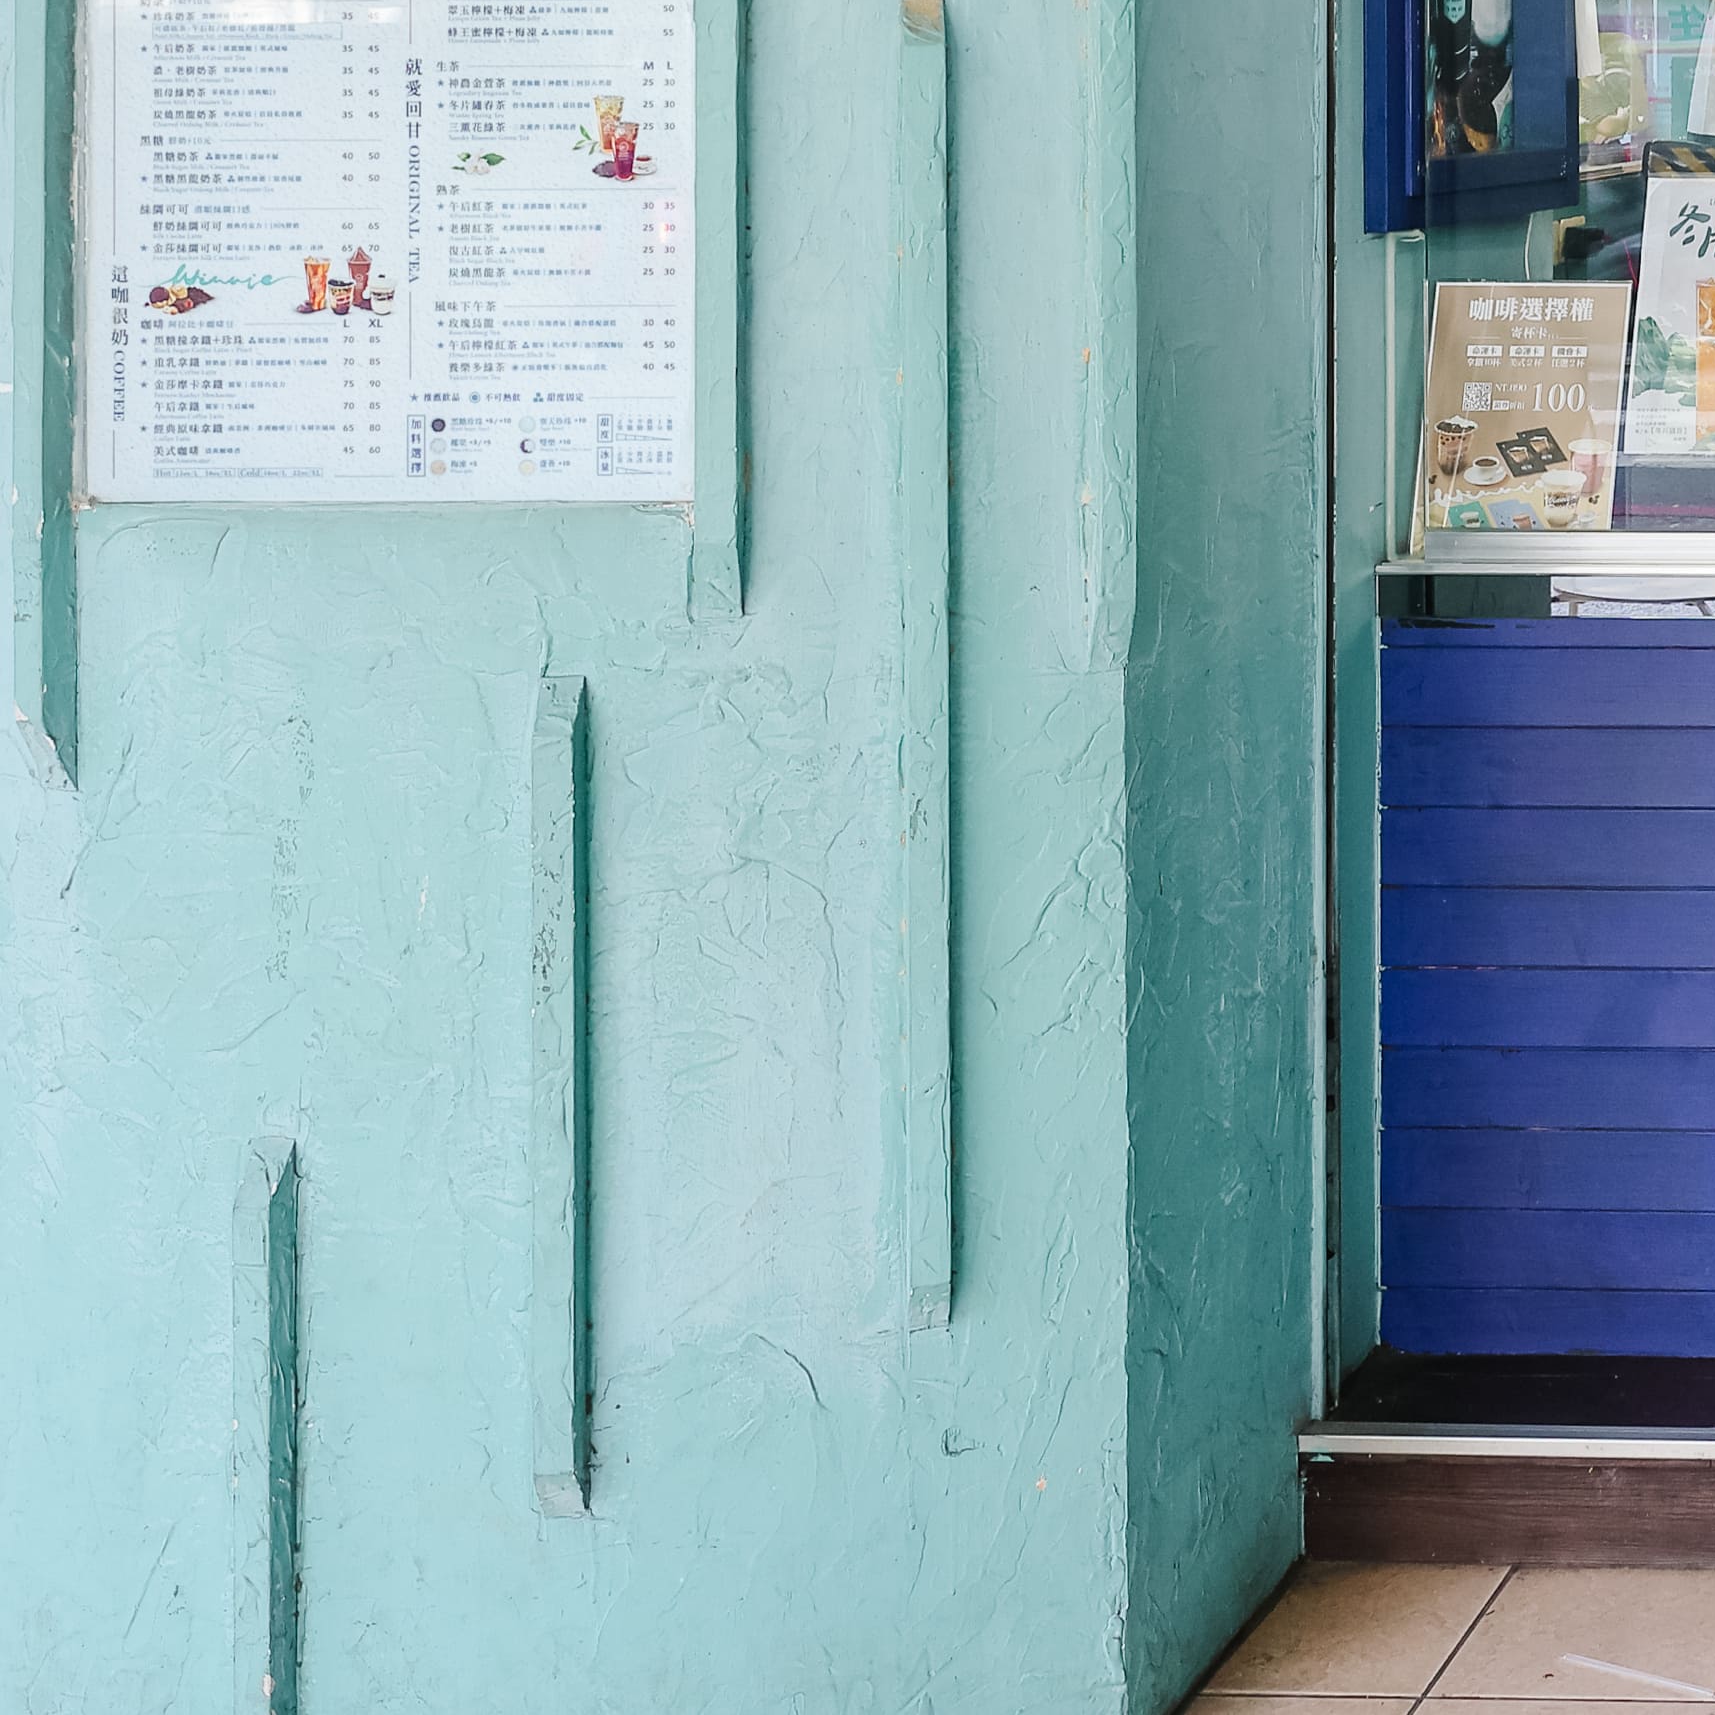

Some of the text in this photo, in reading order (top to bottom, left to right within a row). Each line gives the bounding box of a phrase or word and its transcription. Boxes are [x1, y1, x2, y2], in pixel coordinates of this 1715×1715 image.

[663, 4, 675, 13] 50
[342, 12, 354, 21] 35
[663, 28, 675, 36] 55
[342, 44, 354, 53] 35
[368, 44, 380, 53] 45
[342, 66, 380, 75] 35 45
[643, 62, 655, 70] M
[666, 62, 674, 70] L
[642, 78, 655, 86] 25
[664, 78, 676, 86] 30
[342, 89, 380, 97] 35 45
[405, 57, 423, 140] 就愛回甘
[642, 100, 676, 109] 25 30
[342, 110, 380, 119] 35 45
[642, 122, 676, 131] 25 30
[342, 152, 354, 161] 40
[368, 152, 380, 161] 50
[342, 174, 354, 182] 40
[368, 174, 380, 182] 50
[642, 202, 655, 210] 30
[664, 202, 676, 210] 35
[408, 144, 421, 284] ORIGINAL TEA
[342, 222, 380, 230] 60 65
[642, 224, 655, 232] 25
[664, 224, 676, 232] 30
[342, 244, 380, 252] 65 70
[642, 246, 655, 254] 25
[664, 246, 676, 254] 30
[642, 267, 655, 276] 25
[664, 267, 676, 276] 30
[434, 300, 497, 313] 風味下午茶
[1468, 296, 1595, 322] 咖啡選擇權
[343, 319, 350, 328] L
[368, 319, 383, 328] XL
[642, 318, 655, 327] 30
[664, 318, 676, 327] 40
[1511, 326, 1549, 340] 寄杯卡
[343, 336, 381, 344] 70 85
[642, 340, 655, 349] 45
[664, 340, 676, 349] 50
[343, 358, 381, 366] 70 85
[642, 362, 655, 371] 40
[664, 362, 676, 371] 45
[113, 350, 125, 422] COFFEE
[343, 380, 381, 388] 75 90
[1532, 383, 1586, 412] 100
[343, 402, 355, 410] 70
[369, 402, 381, 410] 85
[343, 424, 355, 432] 65
[369, 424, 381, 432] 80
[343, 446, 355, 454] 45
[369, 446, 381, 454] 60
